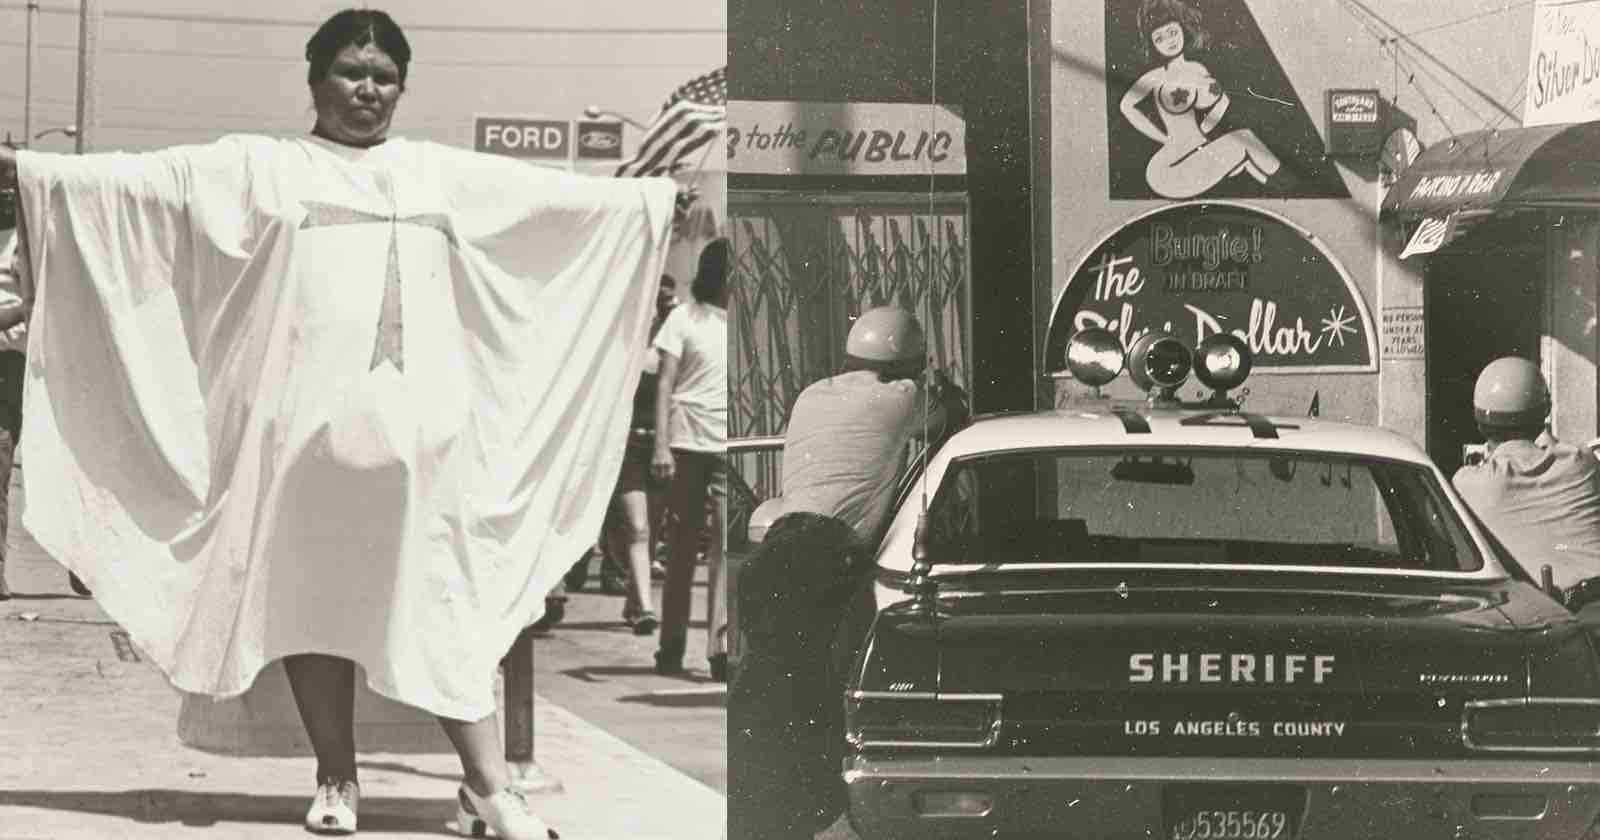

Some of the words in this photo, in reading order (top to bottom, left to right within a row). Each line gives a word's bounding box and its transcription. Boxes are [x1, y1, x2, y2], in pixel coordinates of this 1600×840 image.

[1534, 51, 1579, 109] Silver
[485, 125, 563, 150] FORD
[807, 129, 952, 162] PUBLIC
[1151, 225, 1263, 272] Burgie!
[1088, 252, 1145, 301] The
[1129, 653, 1336, 684] SHERIFF
[1124, 720, 1160, 735] LOS
[1173, 721, 1261, 737] ANGELES
[1273, 722, 1346, 738] COUNTY
